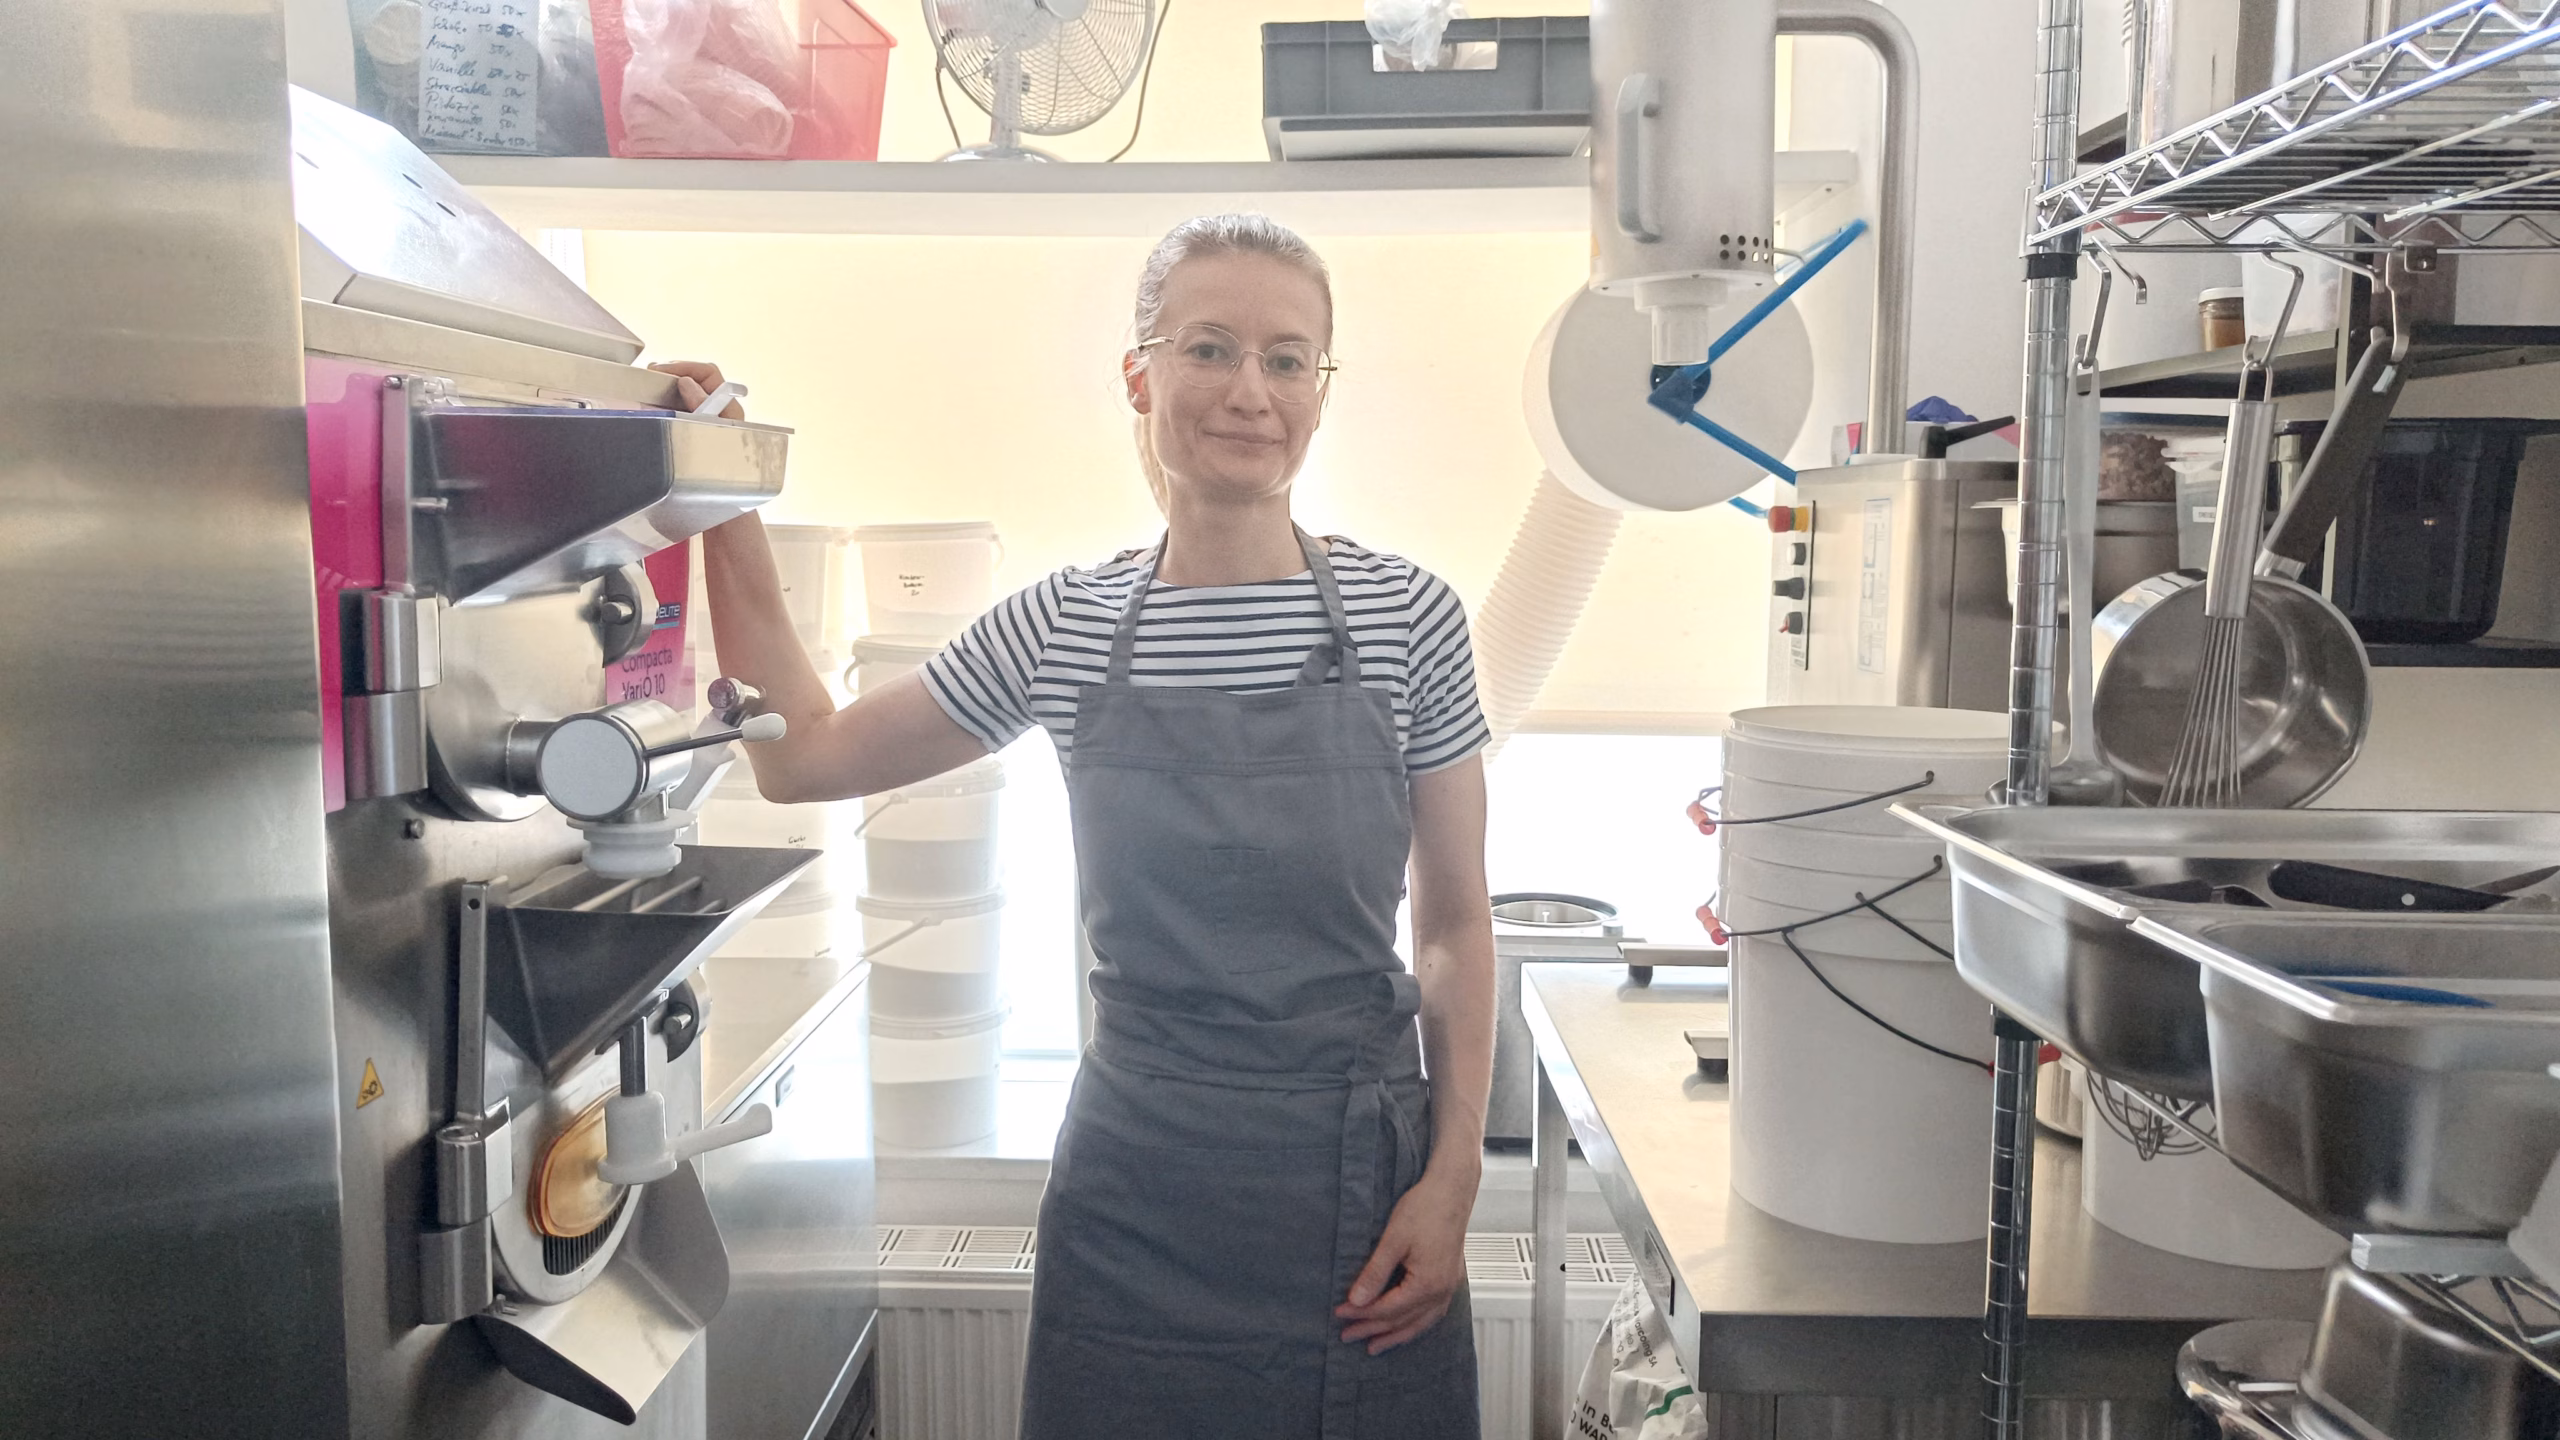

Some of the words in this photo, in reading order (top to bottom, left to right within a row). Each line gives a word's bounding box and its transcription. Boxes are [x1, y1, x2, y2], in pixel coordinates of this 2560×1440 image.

[426, 34, 466, 60] Mango
[430, 58, 477, 77] Vanille
[621, 648, 673, 675] Compacta
[653, 673, 666, 696] 10
[1634, 1316, 1654, 1358] arcoing
